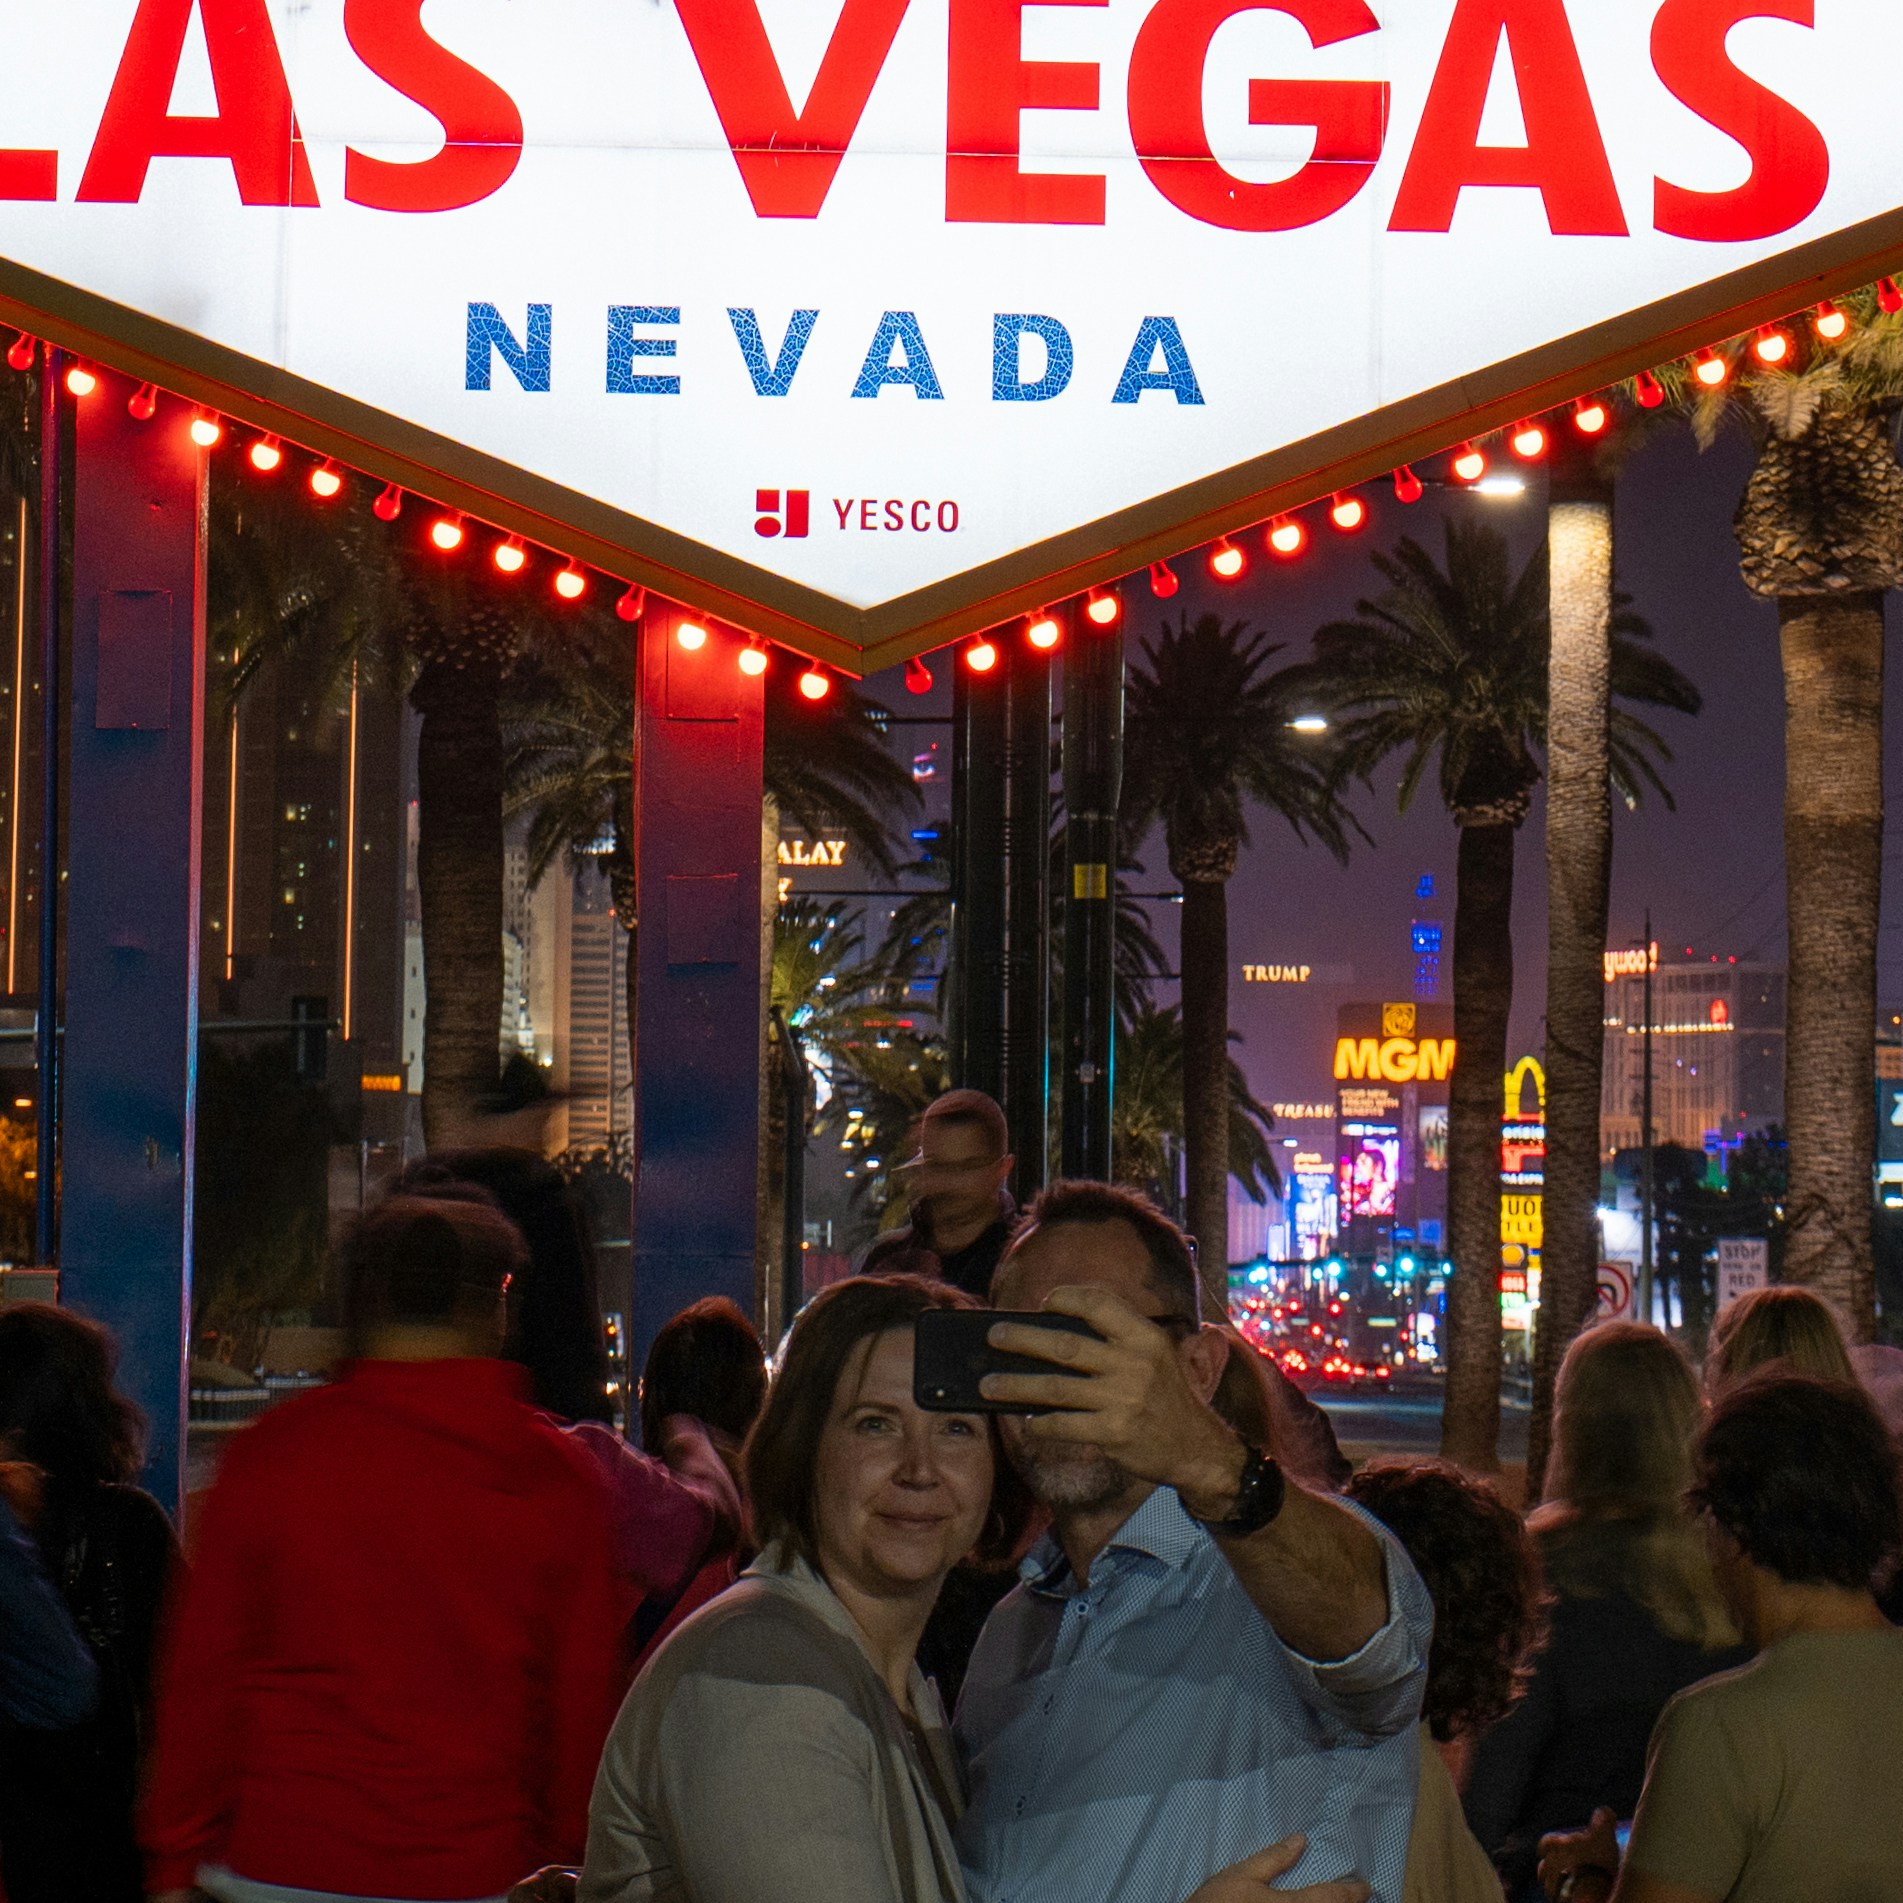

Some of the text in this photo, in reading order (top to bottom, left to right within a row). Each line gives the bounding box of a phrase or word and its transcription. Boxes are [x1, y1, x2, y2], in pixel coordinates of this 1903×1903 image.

[465, 302, 1206, 406] NEVADA
[833, 498, 959, 533] YESCO
[1242, 964, 1311, 982] TRUMP
[1334, 1037, 1456, 1082] MGM
[1273, 1103, 1337, 1119] TREASU
[1725, 1245, 1760, 1260] STOP
[1728, 1273, 1756, 1287] RED
